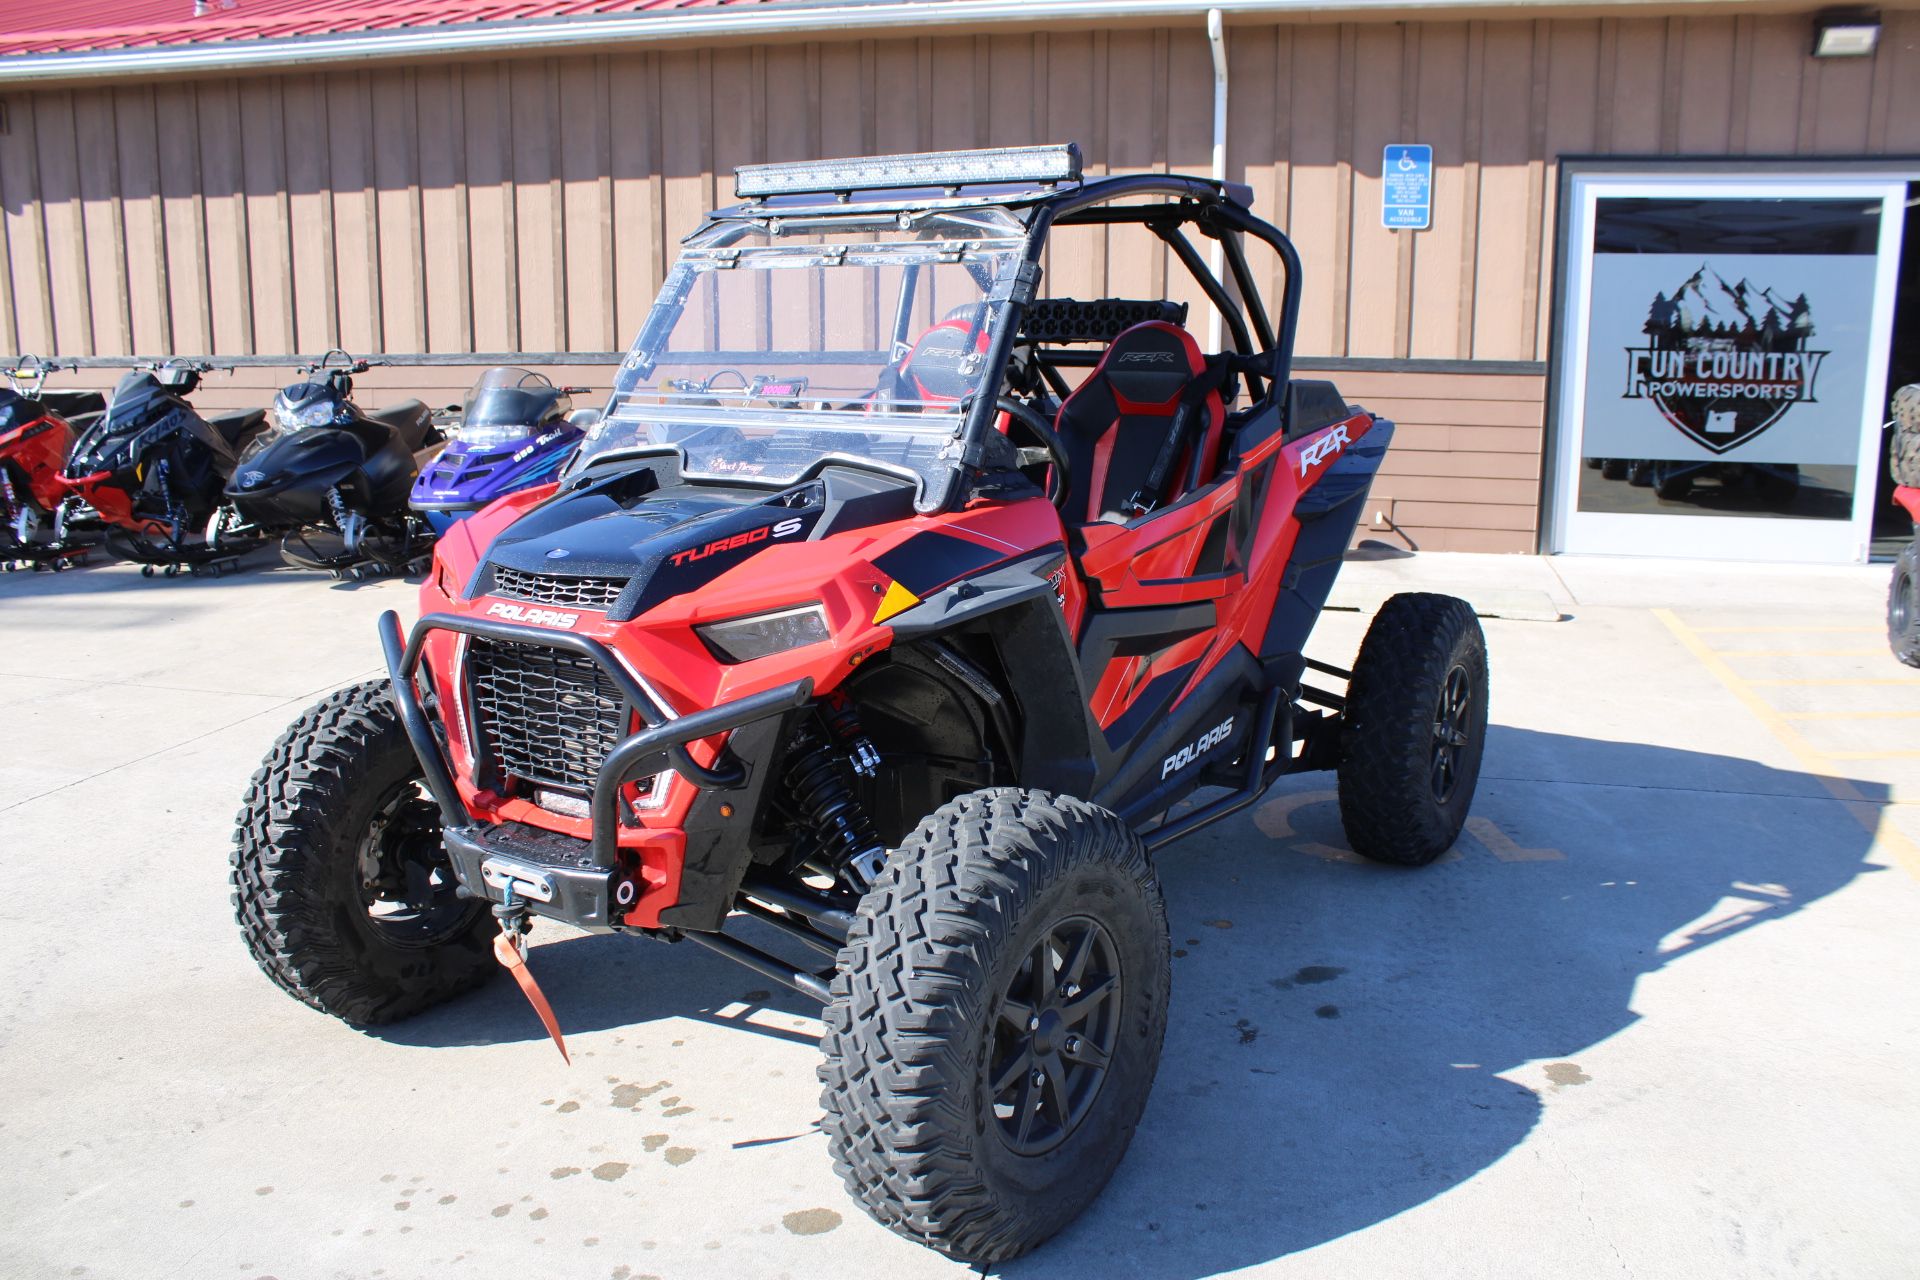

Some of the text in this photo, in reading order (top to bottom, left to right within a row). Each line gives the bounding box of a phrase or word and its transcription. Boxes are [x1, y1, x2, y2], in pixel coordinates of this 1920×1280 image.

[1398, 208, 1415, 217] VAN
[1118, 351, 1175, 362] RZR
[1624, 348, 1829, 402] FUN COUNTRY
[1649, 381, 1798, 400] POWERSPORTS
[1301, 424, 1352, 478] RZR
[669, 517, 802, 567] TURBO S
[486, 602, 579, 629] POLARIS
[1161, 716, 1234, 780] POLARIS
